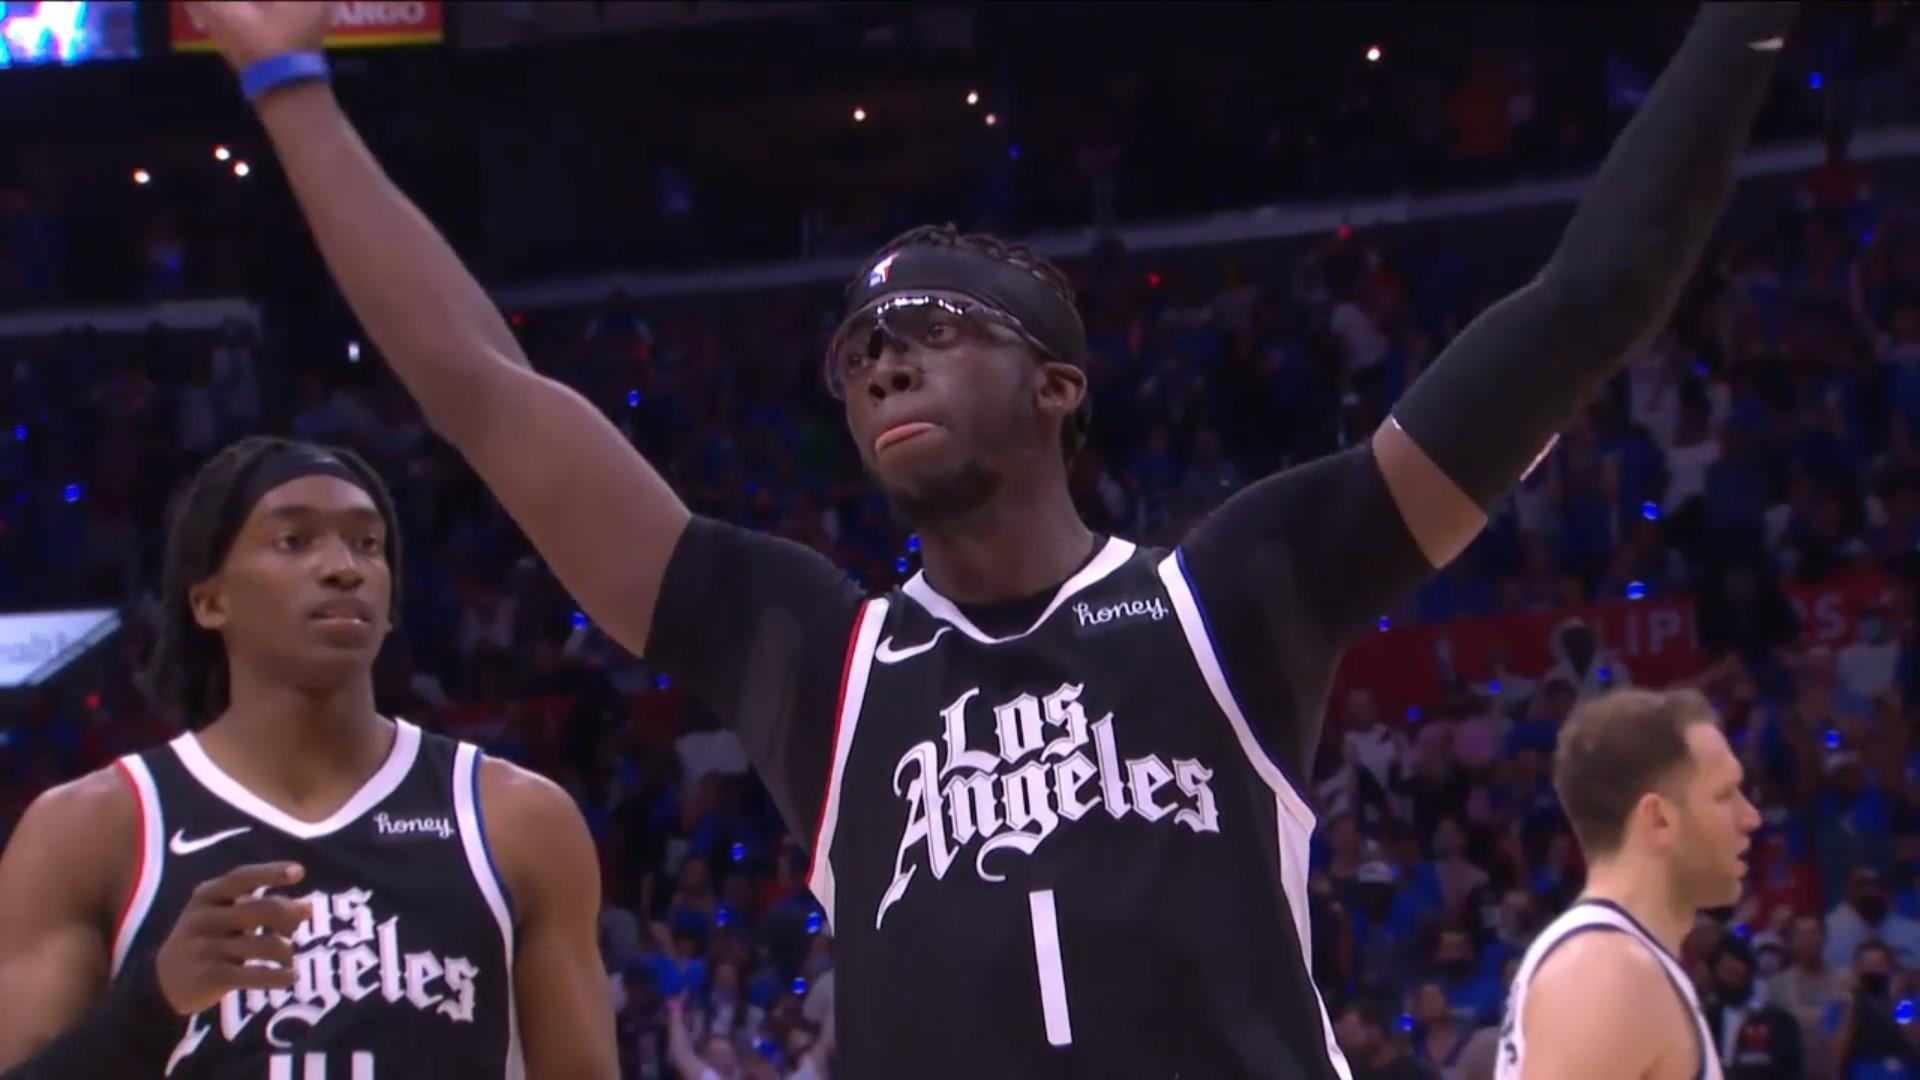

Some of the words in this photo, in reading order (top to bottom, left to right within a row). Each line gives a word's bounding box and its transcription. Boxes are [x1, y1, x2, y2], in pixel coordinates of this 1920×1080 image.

[333, 1, 426, 25] ARGO
[1072, 597, 1168, 626] honey
[939, 683, 1089, 781] Los
[373, 812, 455, 839] honey
[876, 712, 1220, 930] Angeles
[1029, 889, 1072, 1046] 1
